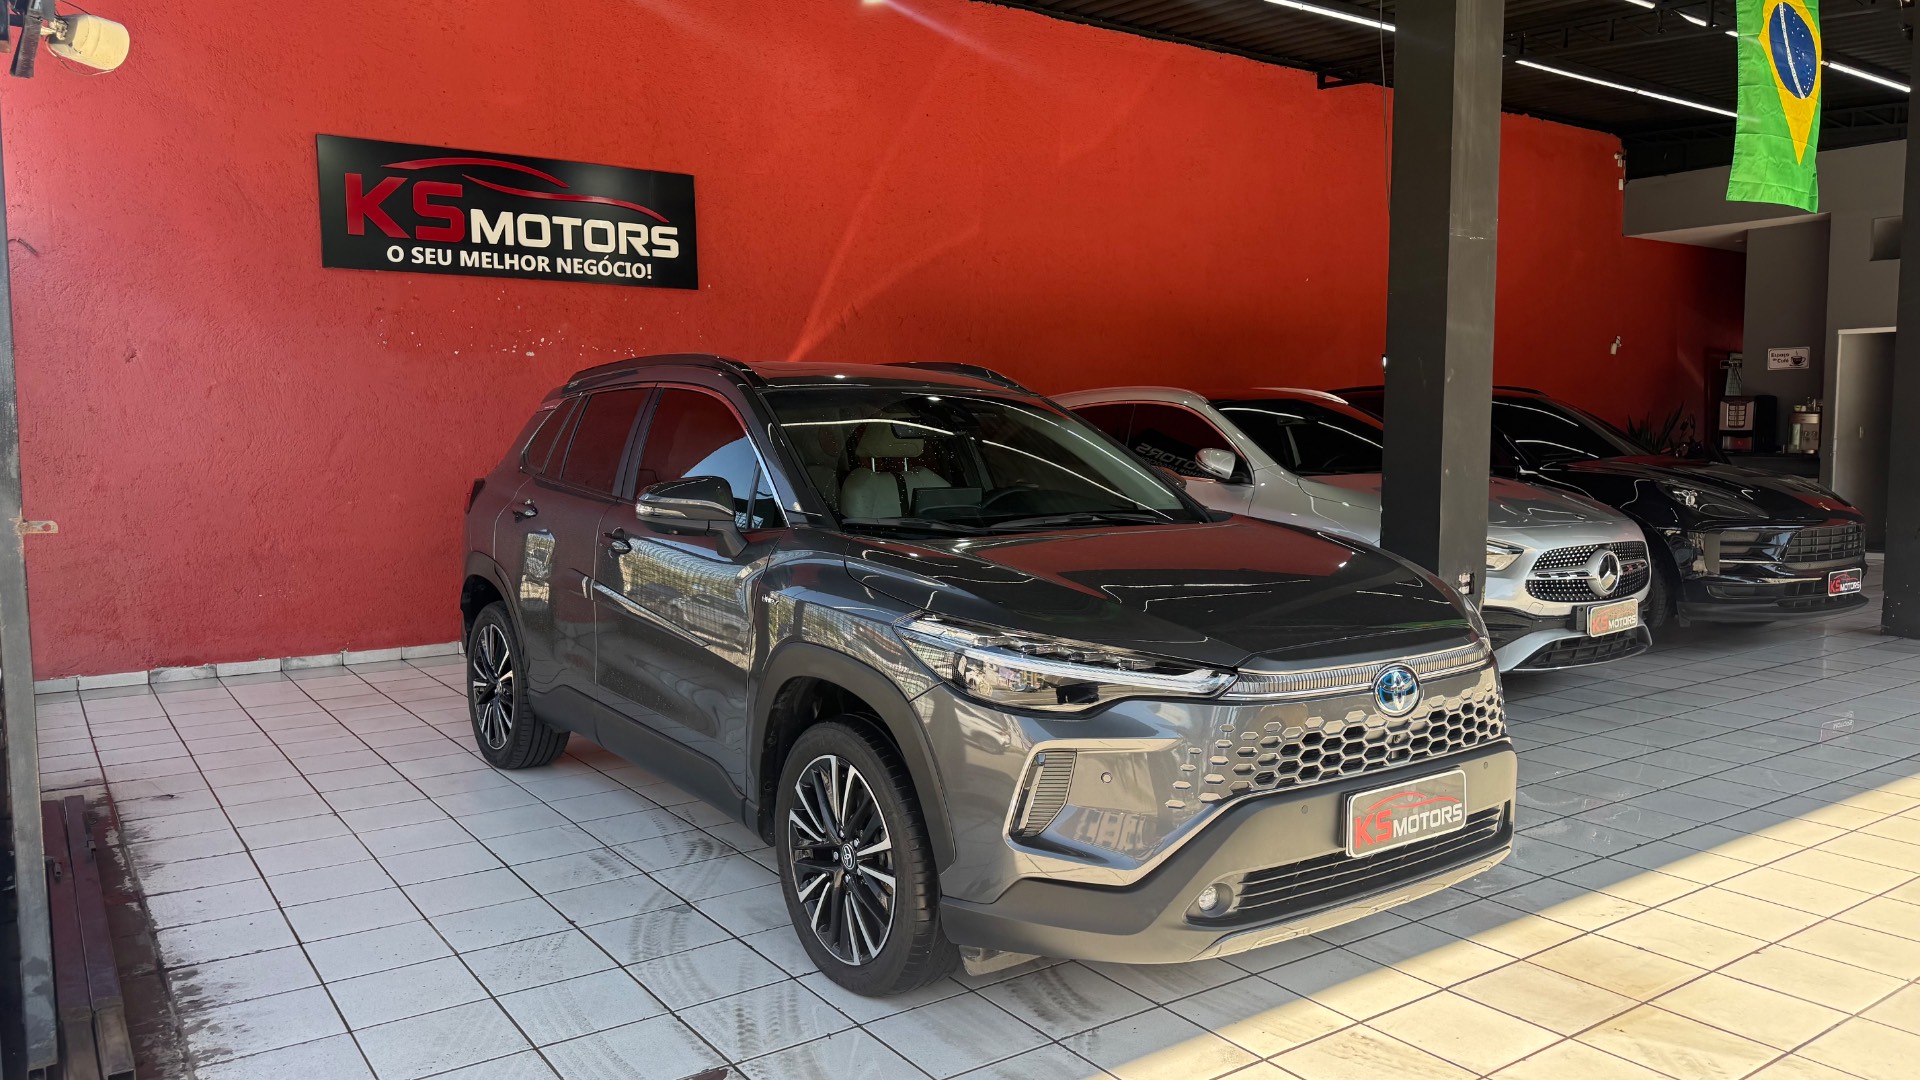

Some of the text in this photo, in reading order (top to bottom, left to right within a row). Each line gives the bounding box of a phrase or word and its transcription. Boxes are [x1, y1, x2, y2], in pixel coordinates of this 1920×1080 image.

[344, 172, 680, 259] KS MOTORS
[386, 245, 652, 280] O SEU MELHOR NEGÓCIO!
[1840, 581, 1860, 591] MOTORS
[1592, 614, 1636, 633] KS MOTORS
[1354, 802, 1463, 849] KS MOTORS
